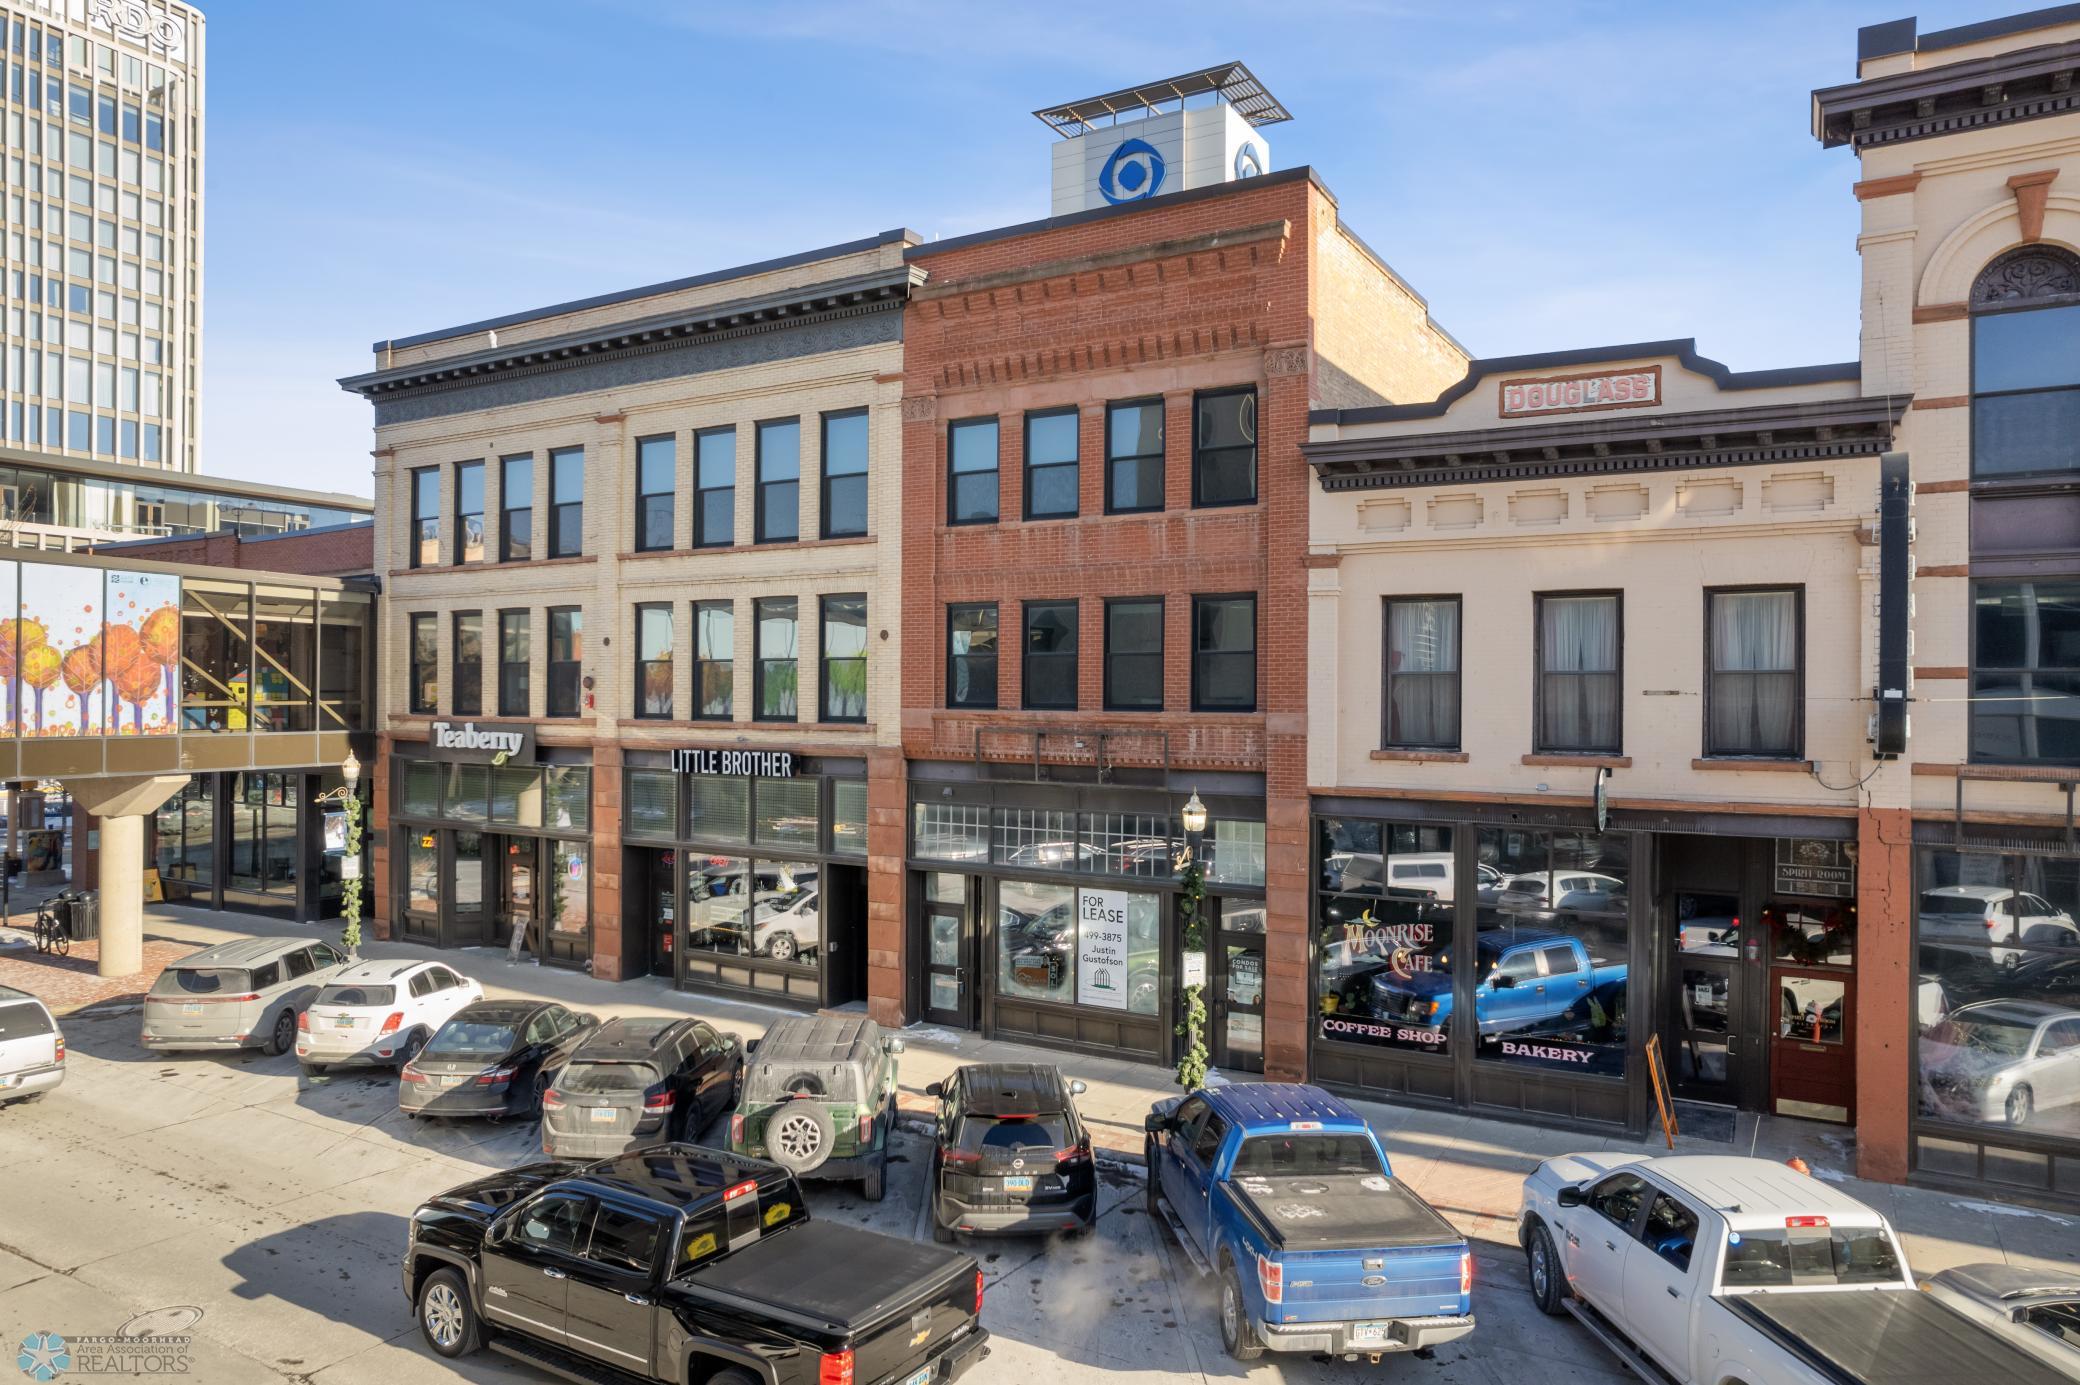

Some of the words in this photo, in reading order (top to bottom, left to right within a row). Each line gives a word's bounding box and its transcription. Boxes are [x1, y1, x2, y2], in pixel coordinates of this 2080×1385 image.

[88, 0, 184, 48] RDO
[1509, 374, 1649, 409] DOUGLASS
[433, 722, 524, 756] Teaberry
[671, 749, 718, 774] LITTLE
[721, 751, 792, 777] BROTHER
[1782, 867, 1812, 878] SPIRIT
[1816, 870, 1846, 880] ROOM
[1082, 895, 1104, 907] FOR
[1082, 907, 1124, 923] LEASE
[1092, 945, 1116, 955] Justin
[1343, 923, 1434, 956] MOONRISE
[1323, 1019, 1392, 1038] COFFEE
[1396, 1028, 1447, 1045] SHOP
[1501, 1041, 1595, 1064] BAKERY
